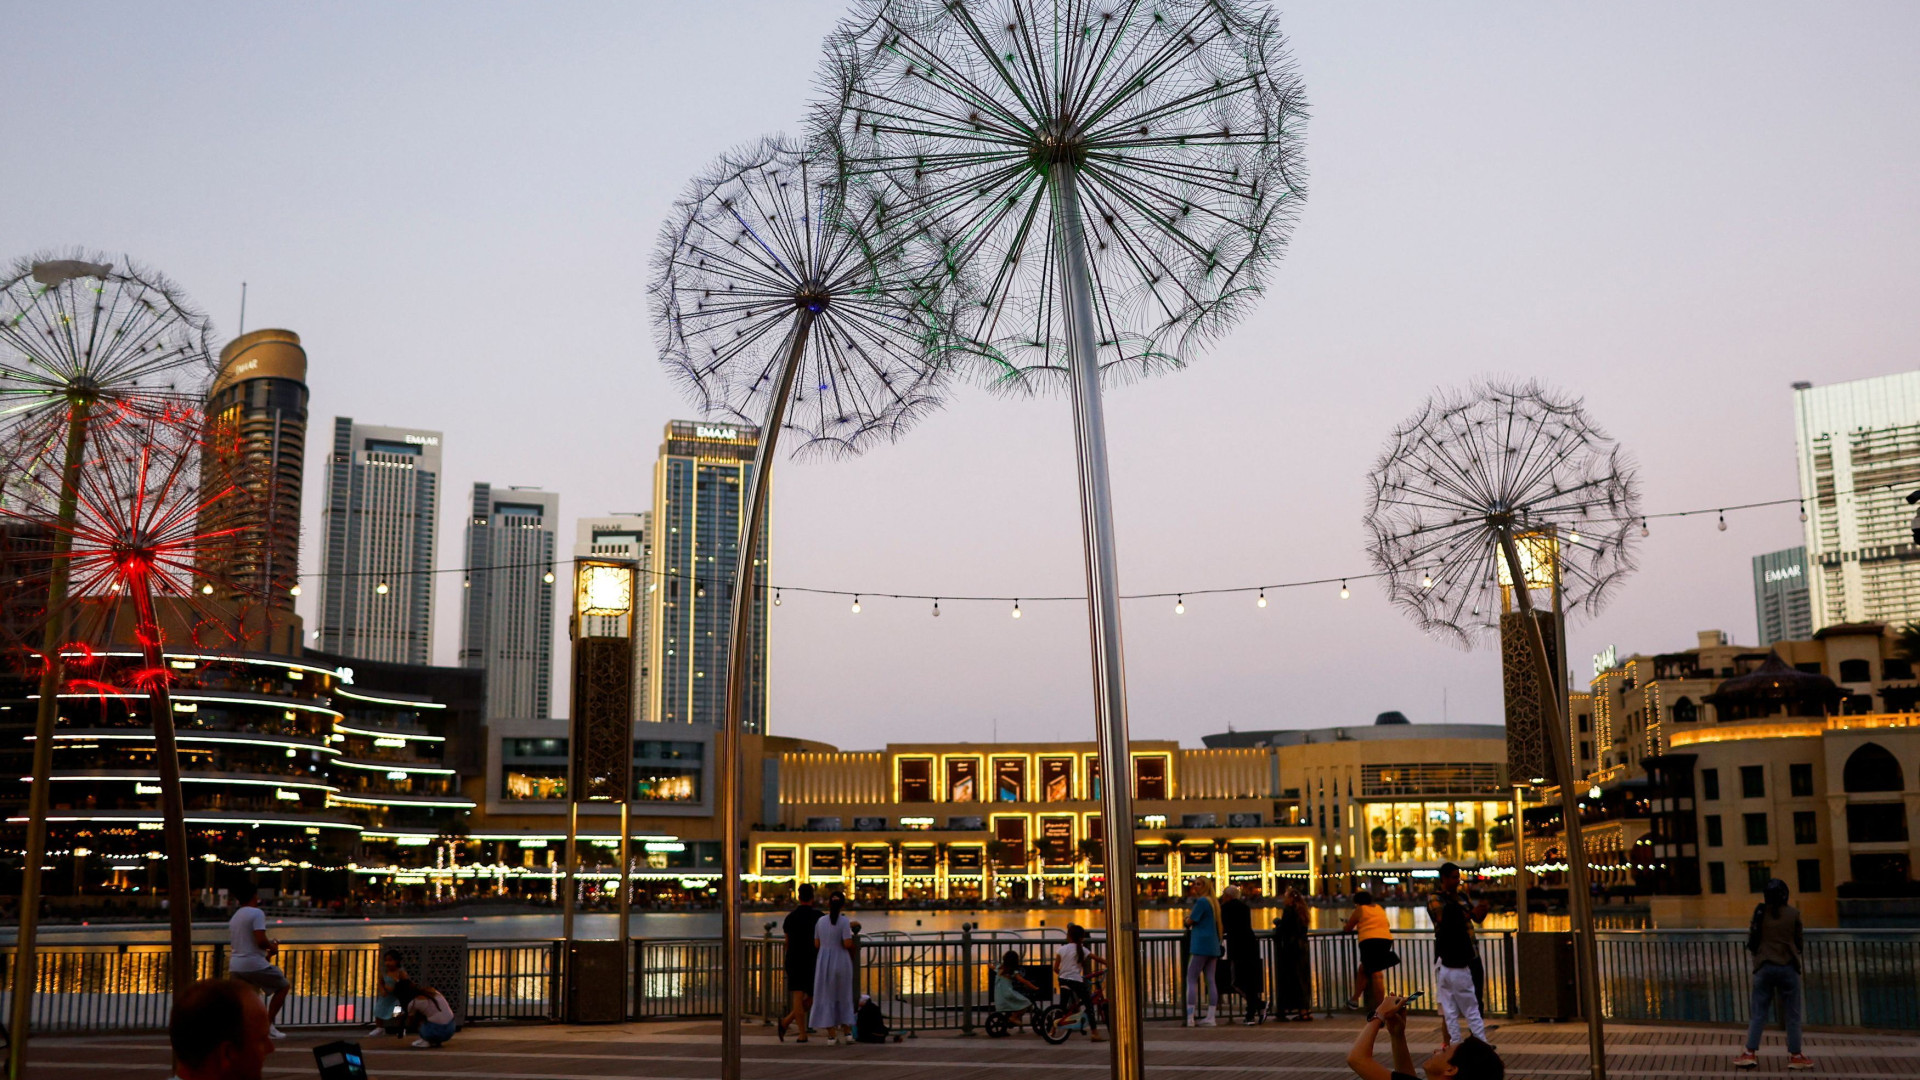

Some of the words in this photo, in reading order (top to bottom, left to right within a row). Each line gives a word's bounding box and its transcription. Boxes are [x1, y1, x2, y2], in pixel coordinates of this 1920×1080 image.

[696, 426, 737, 440] EMAAR
[405, 434, 439, 447] EMAAR
[1764, 564, 1802, 583] EMAAR
